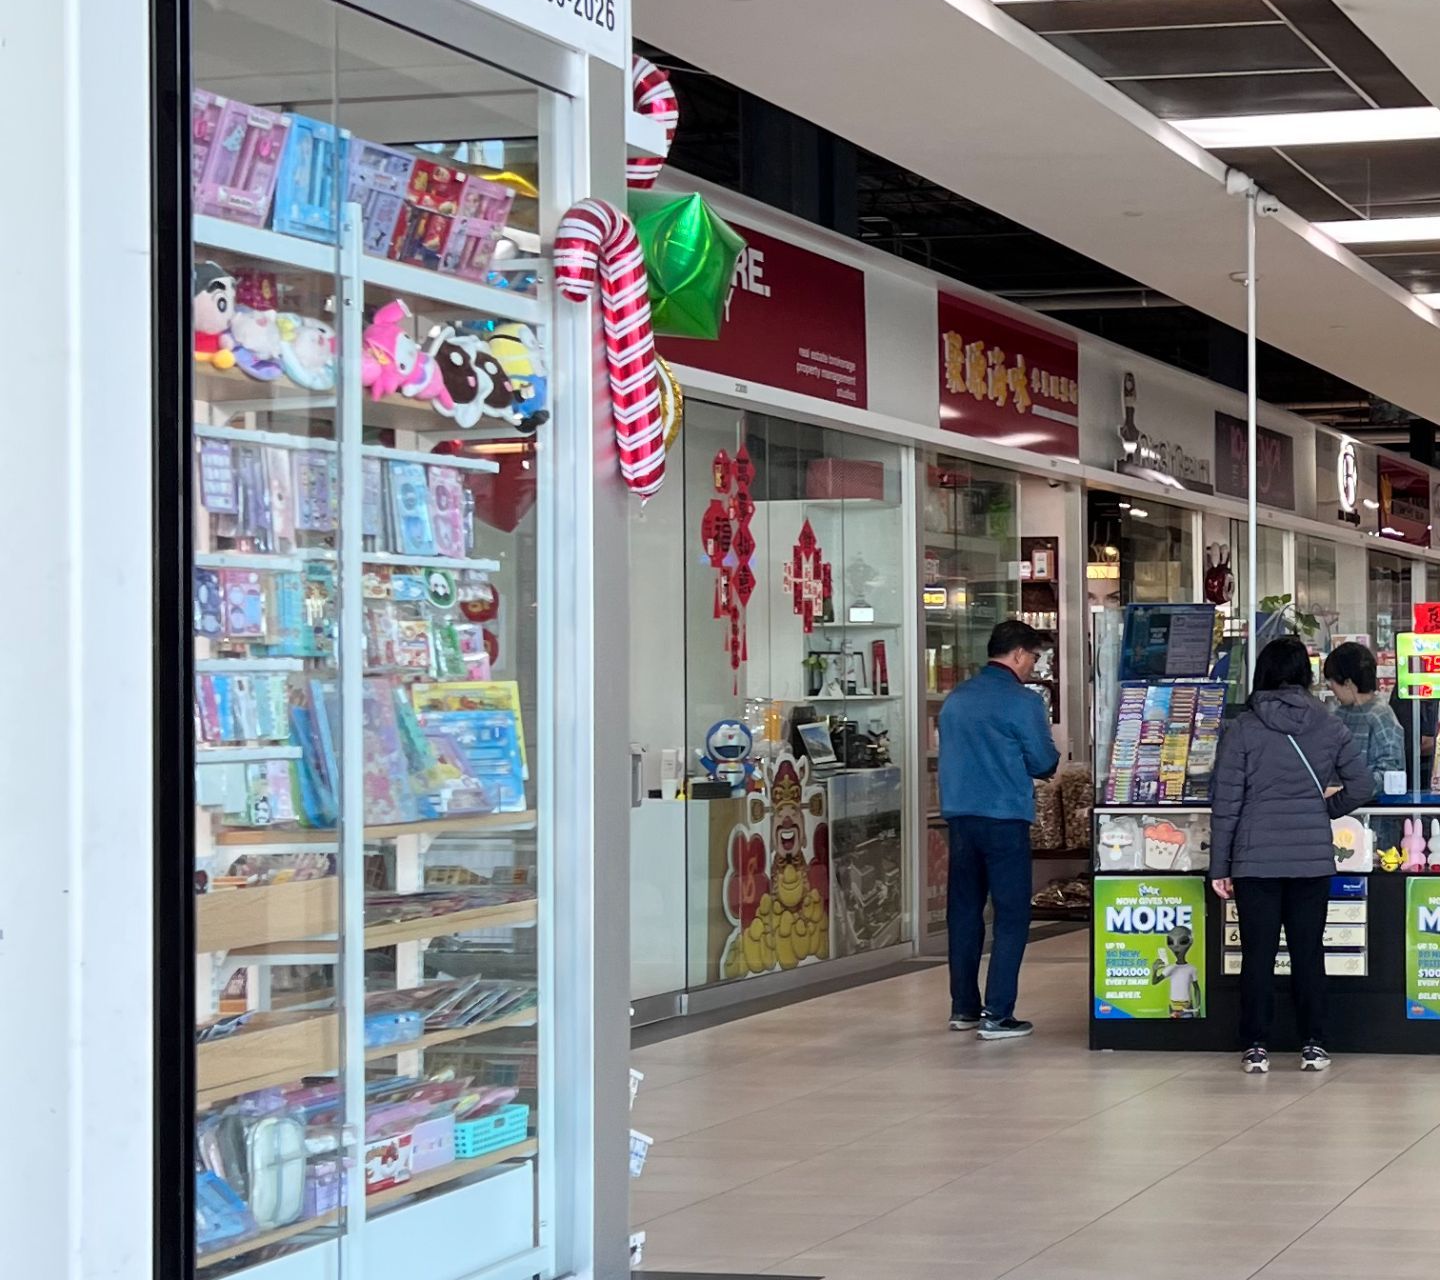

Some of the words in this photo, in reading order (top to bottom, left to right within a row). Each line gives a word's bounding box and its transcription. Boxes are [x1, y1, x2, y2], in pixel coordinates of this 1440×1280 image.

[1116, 897, 1138, 905] NOW
[1138, 897, 1163, 905] GIVES
[1164, 897, 1182, 905] YOU
[1106, 905, 1192, 932] MORE
